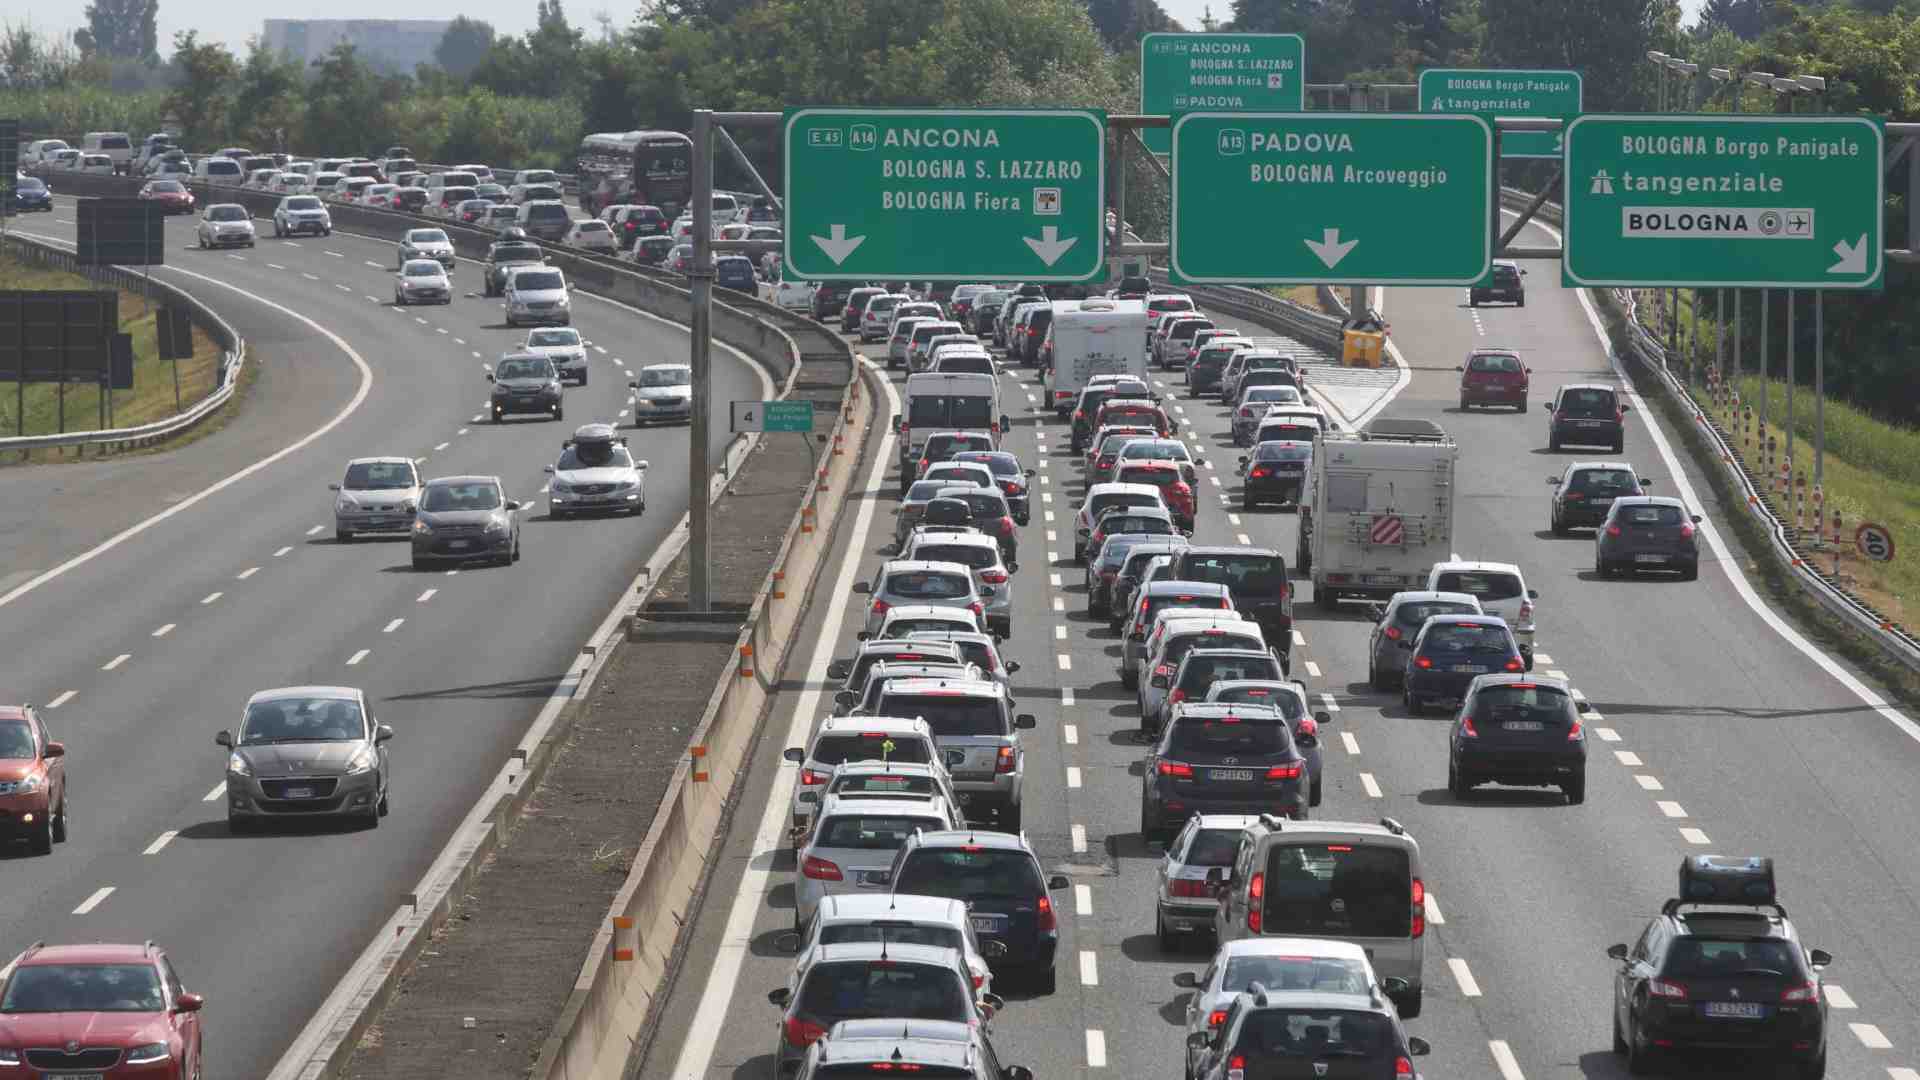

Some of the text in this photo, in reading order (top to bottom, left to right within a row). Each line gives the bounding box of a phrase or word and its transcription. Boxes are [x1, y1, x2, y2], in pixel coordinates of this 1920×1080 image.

[1191, 43, 1251, 54] ANCONA
[1190, 59, 1234, 70] BOLOGNA
[1251, 59, 1294, 71] LAZZARO
[1190, 75, 1233, 86] BOLOGNA
[1448, 79, 1493, 90] BOLOGNA
[1190, 96, 1243, 107] PADOVA
[1448, 98, 1531, 112] tangenziale
[811, 132, 820, 143] E
[825, 132, 839, 143] 45
[883, 128, 1000, 147] ANCONA
[1251, 132, 1354, 152] PADOVA
[1622, 135, 1859, 160] BOLOGNA Borgo Panigale
[882, 159, 1082, 179] BOLOGNA S. LAZZARO
[1251, 163, 1448, 188] BOLOGNA Arcoveggio
[1623, 171, 1784, 195] tangenziale
[882, 191, 1021, 210] BOLOGNA Fiera
[1629, 213, 1749, 231] BOLOGNA
